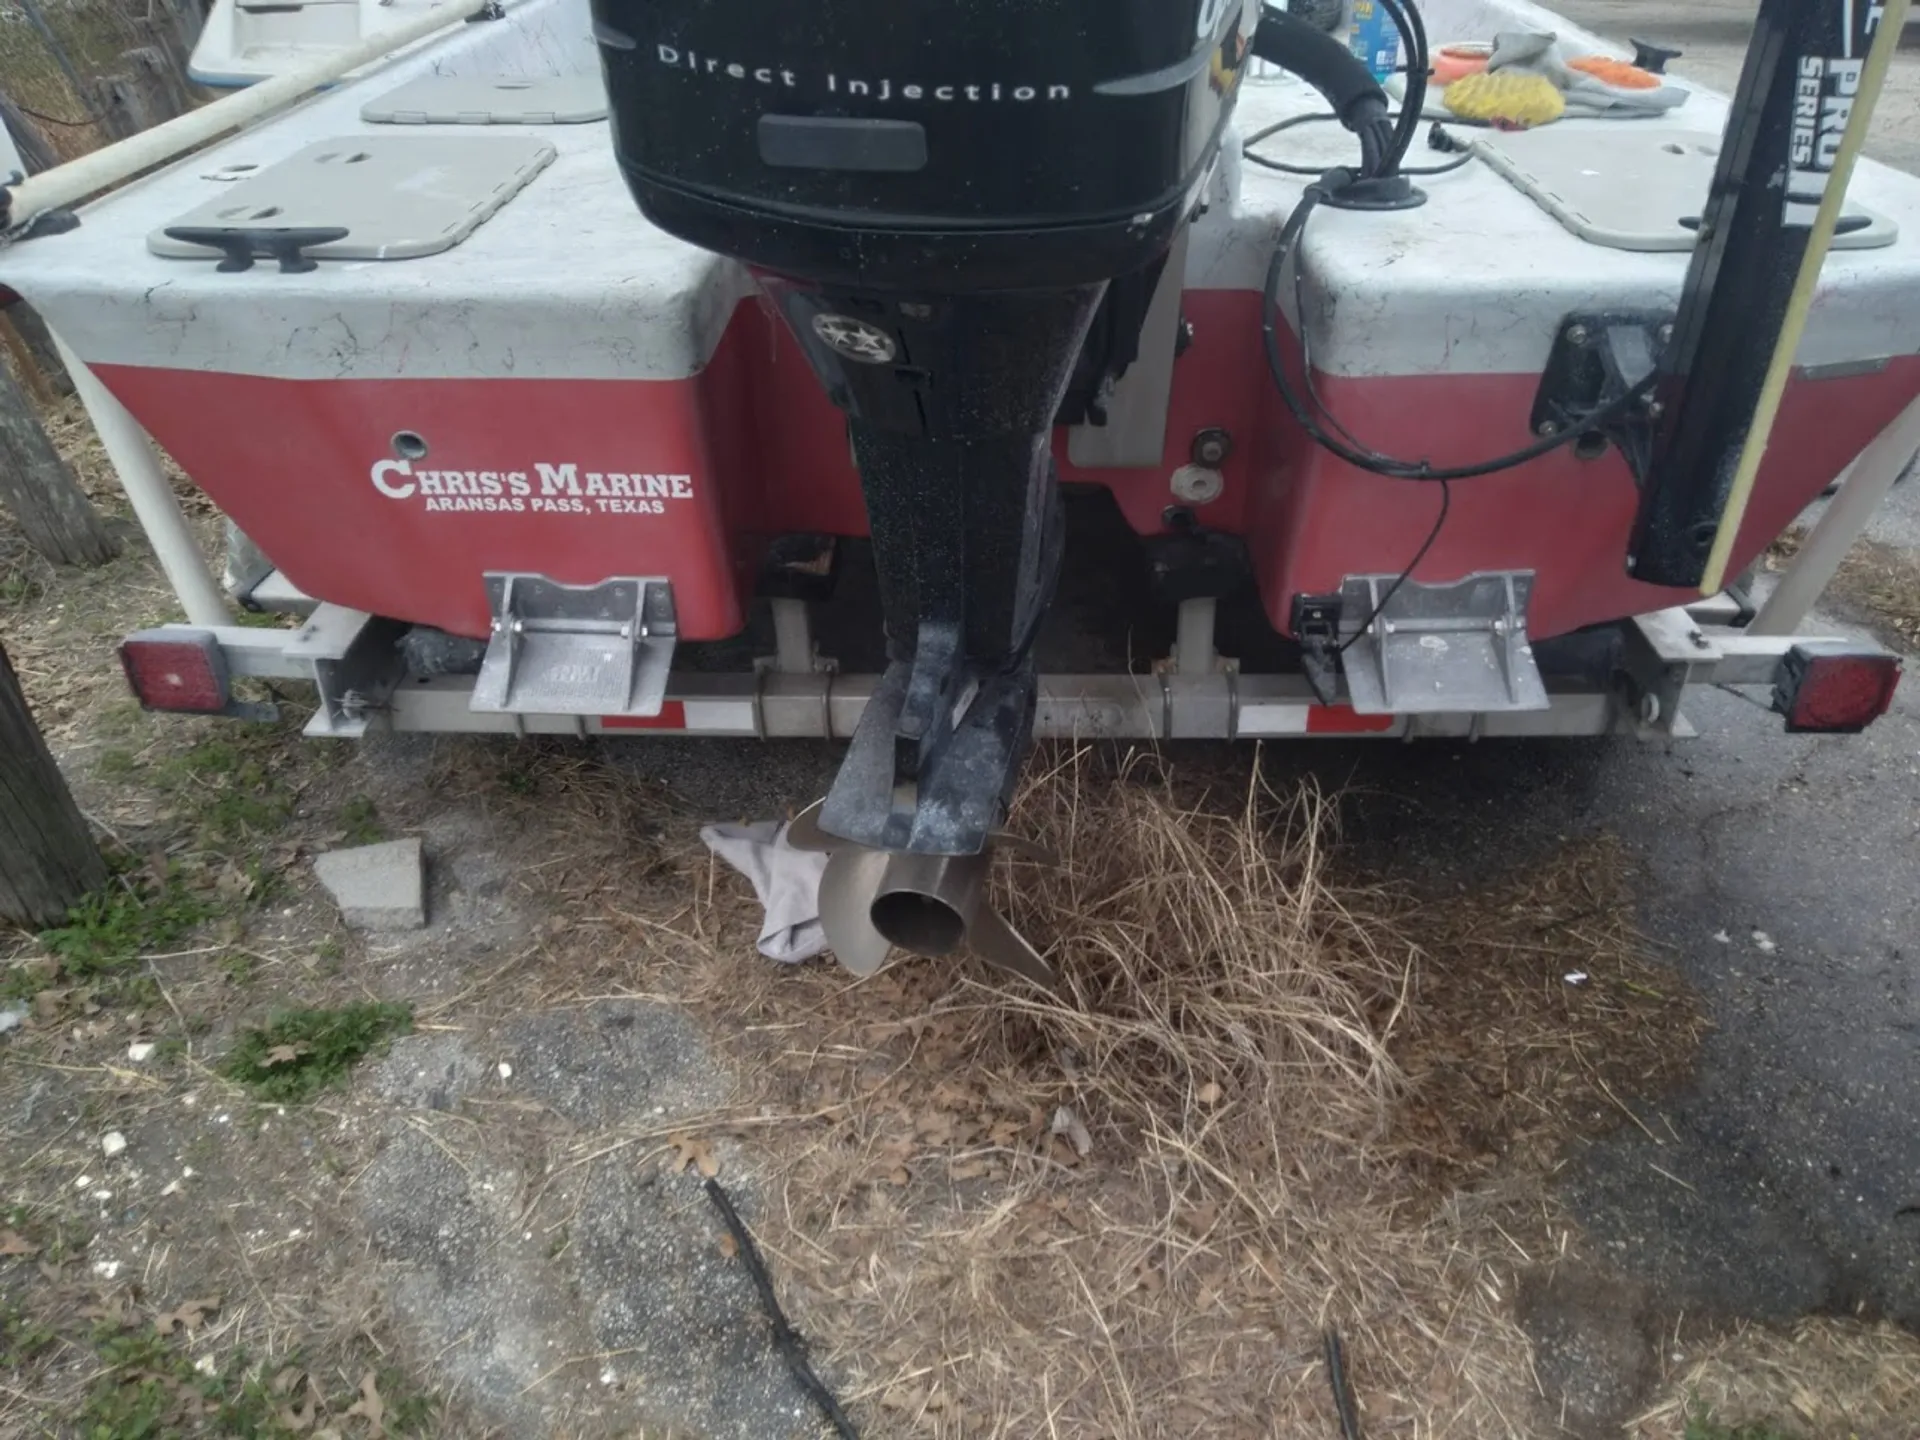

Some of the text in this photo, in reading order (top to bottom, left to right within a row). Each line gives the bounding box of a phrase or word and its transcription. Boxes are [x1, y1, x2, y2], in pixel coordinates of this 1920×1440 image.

[657, 43, 1071, 101] Direct Injection
[1791, 55, 1824, 166] SERIES
[370, 458, 694, 499] CHRIS'S MARINE
[425, 497, 665, 516] ARANSAS PASS, TEXAS
